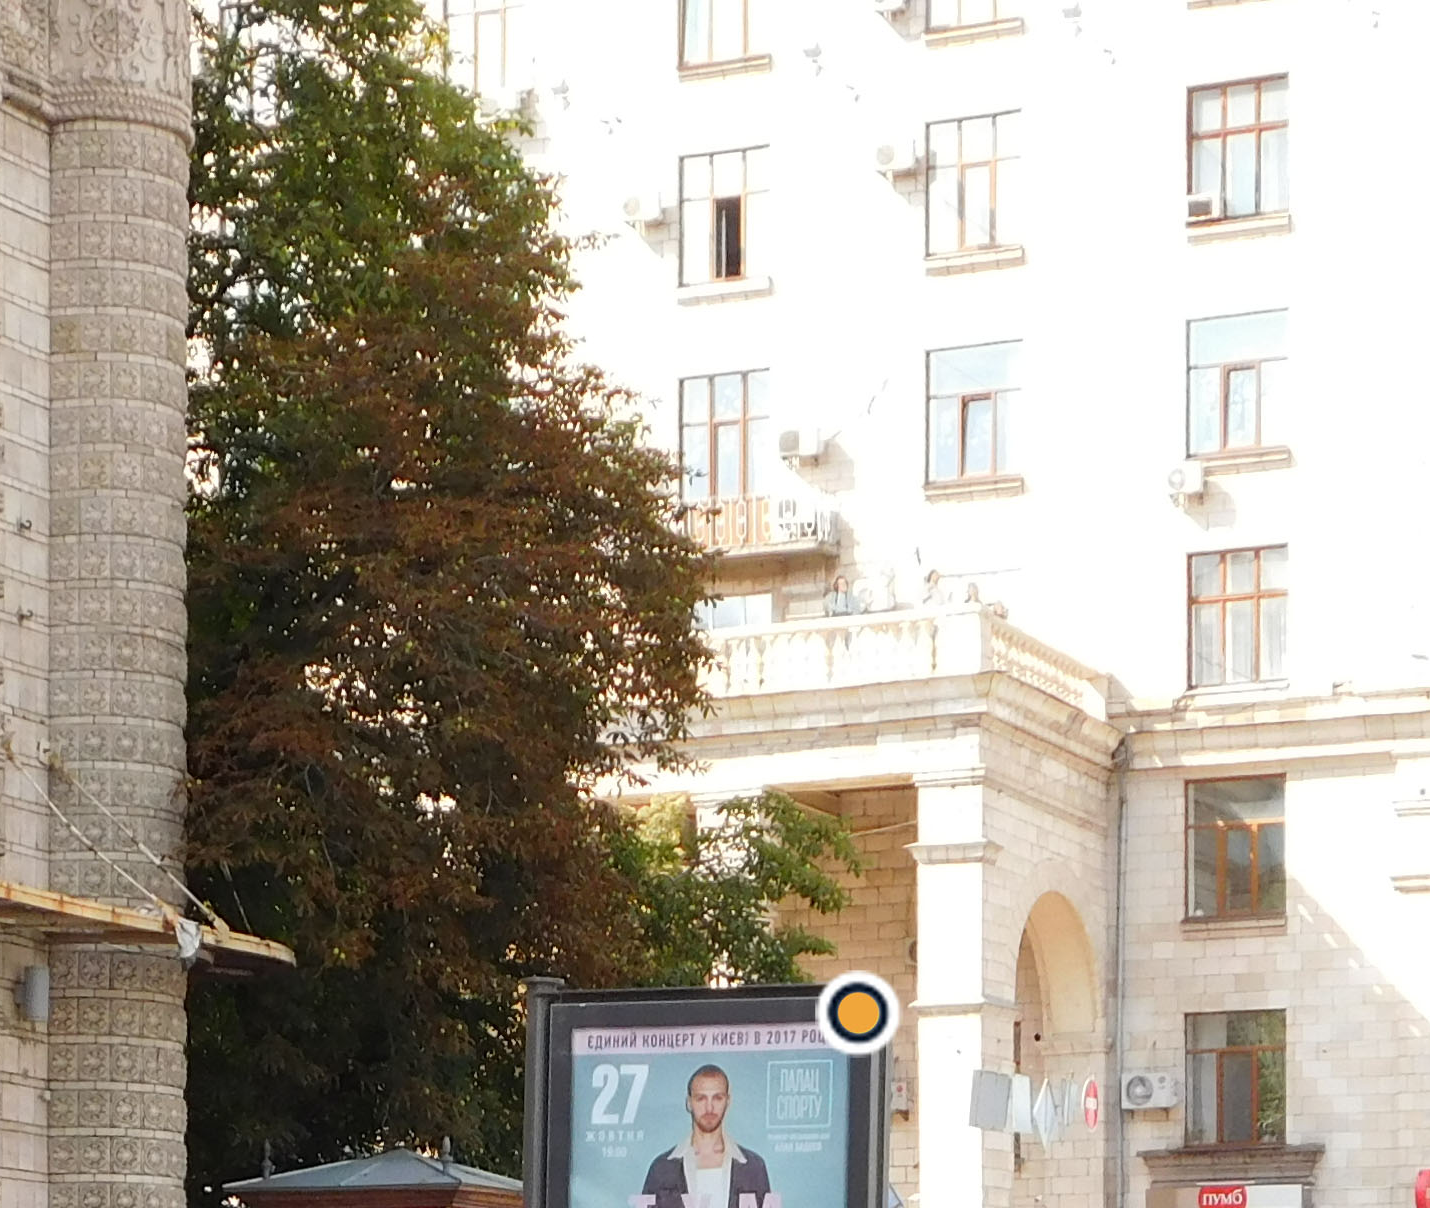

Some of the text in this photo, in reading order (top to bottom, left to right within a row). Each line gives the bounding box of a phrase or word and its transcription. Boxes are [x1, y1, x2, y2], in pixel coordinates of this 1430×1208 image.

[587, 1029, 826, 1050] ЄДИНИЙ КОНЦЕРТ У КИЄВІ В 2017 РОЦ
[591, 1063, 649, 1125] 27
[779, 1068, 820, 1094] ПАЛАЦ
[776, 1094, 823, 1120] СПОРТУ
[585, 1130, 644, 1143] ЖОВТНЯ
